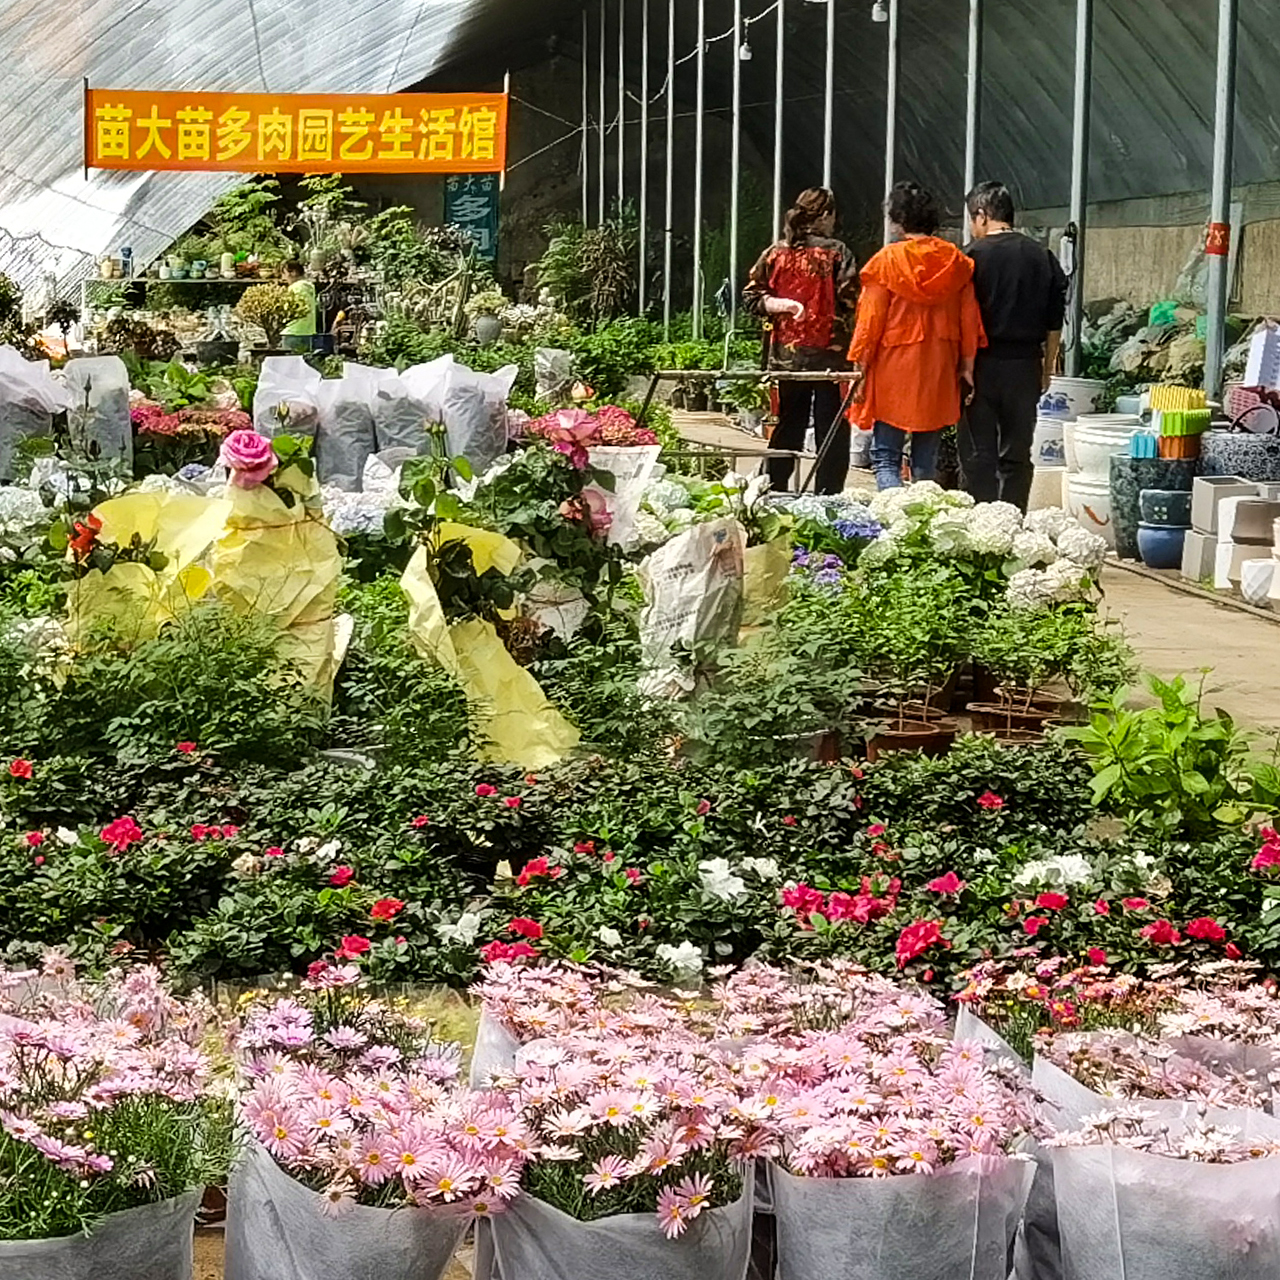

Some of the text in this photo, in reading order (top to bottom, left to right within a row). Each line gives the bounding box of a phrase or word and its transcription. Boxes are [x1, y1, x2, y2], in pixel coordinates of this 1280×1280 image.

[95, 102, 497, 162] 苗大苗多肉园艺生活馆
[450, 195, 494, 261] 多肉
